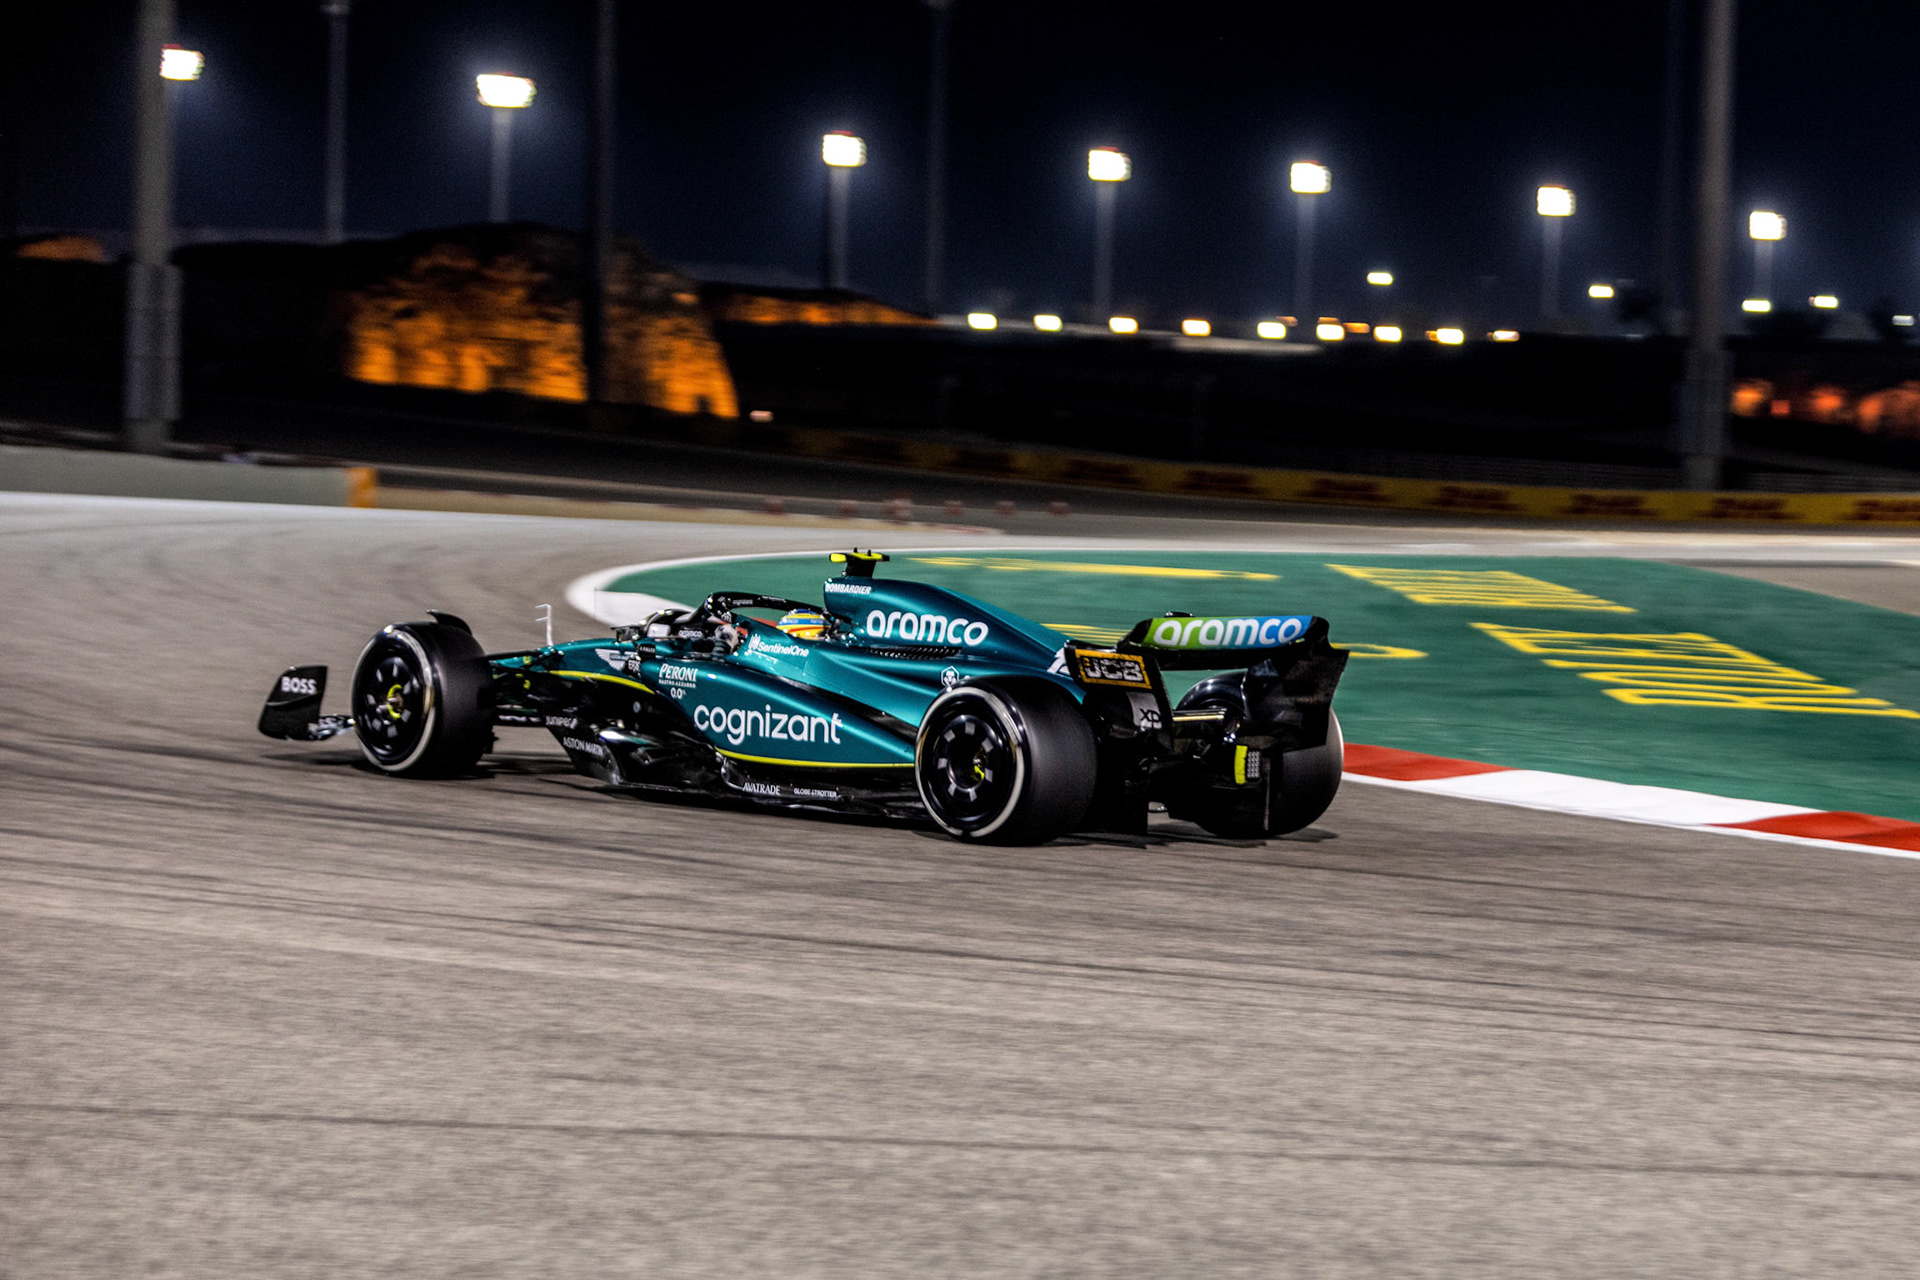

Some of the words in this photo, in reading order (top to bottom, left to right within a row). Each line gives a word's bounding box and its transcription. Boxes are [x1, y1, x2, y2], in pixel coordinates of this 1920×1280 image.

[825, 582, 872, 595] BOMBARDIER
[866, 609, 989, 647] aramco
[1153, 618, 1302, 646] aramco
[757, 641, 810, 658] SentinelOne
[658, 663, 698, 682] PERONI
[1084, 658, 1144, 681] JCB
[1466, 622, 1920, 719] ROLEX
[281, 676, 317, 695] BOSS
[693, 704, 844, 745] cognizant
[742, 782, 781, 796] AVATRADE
